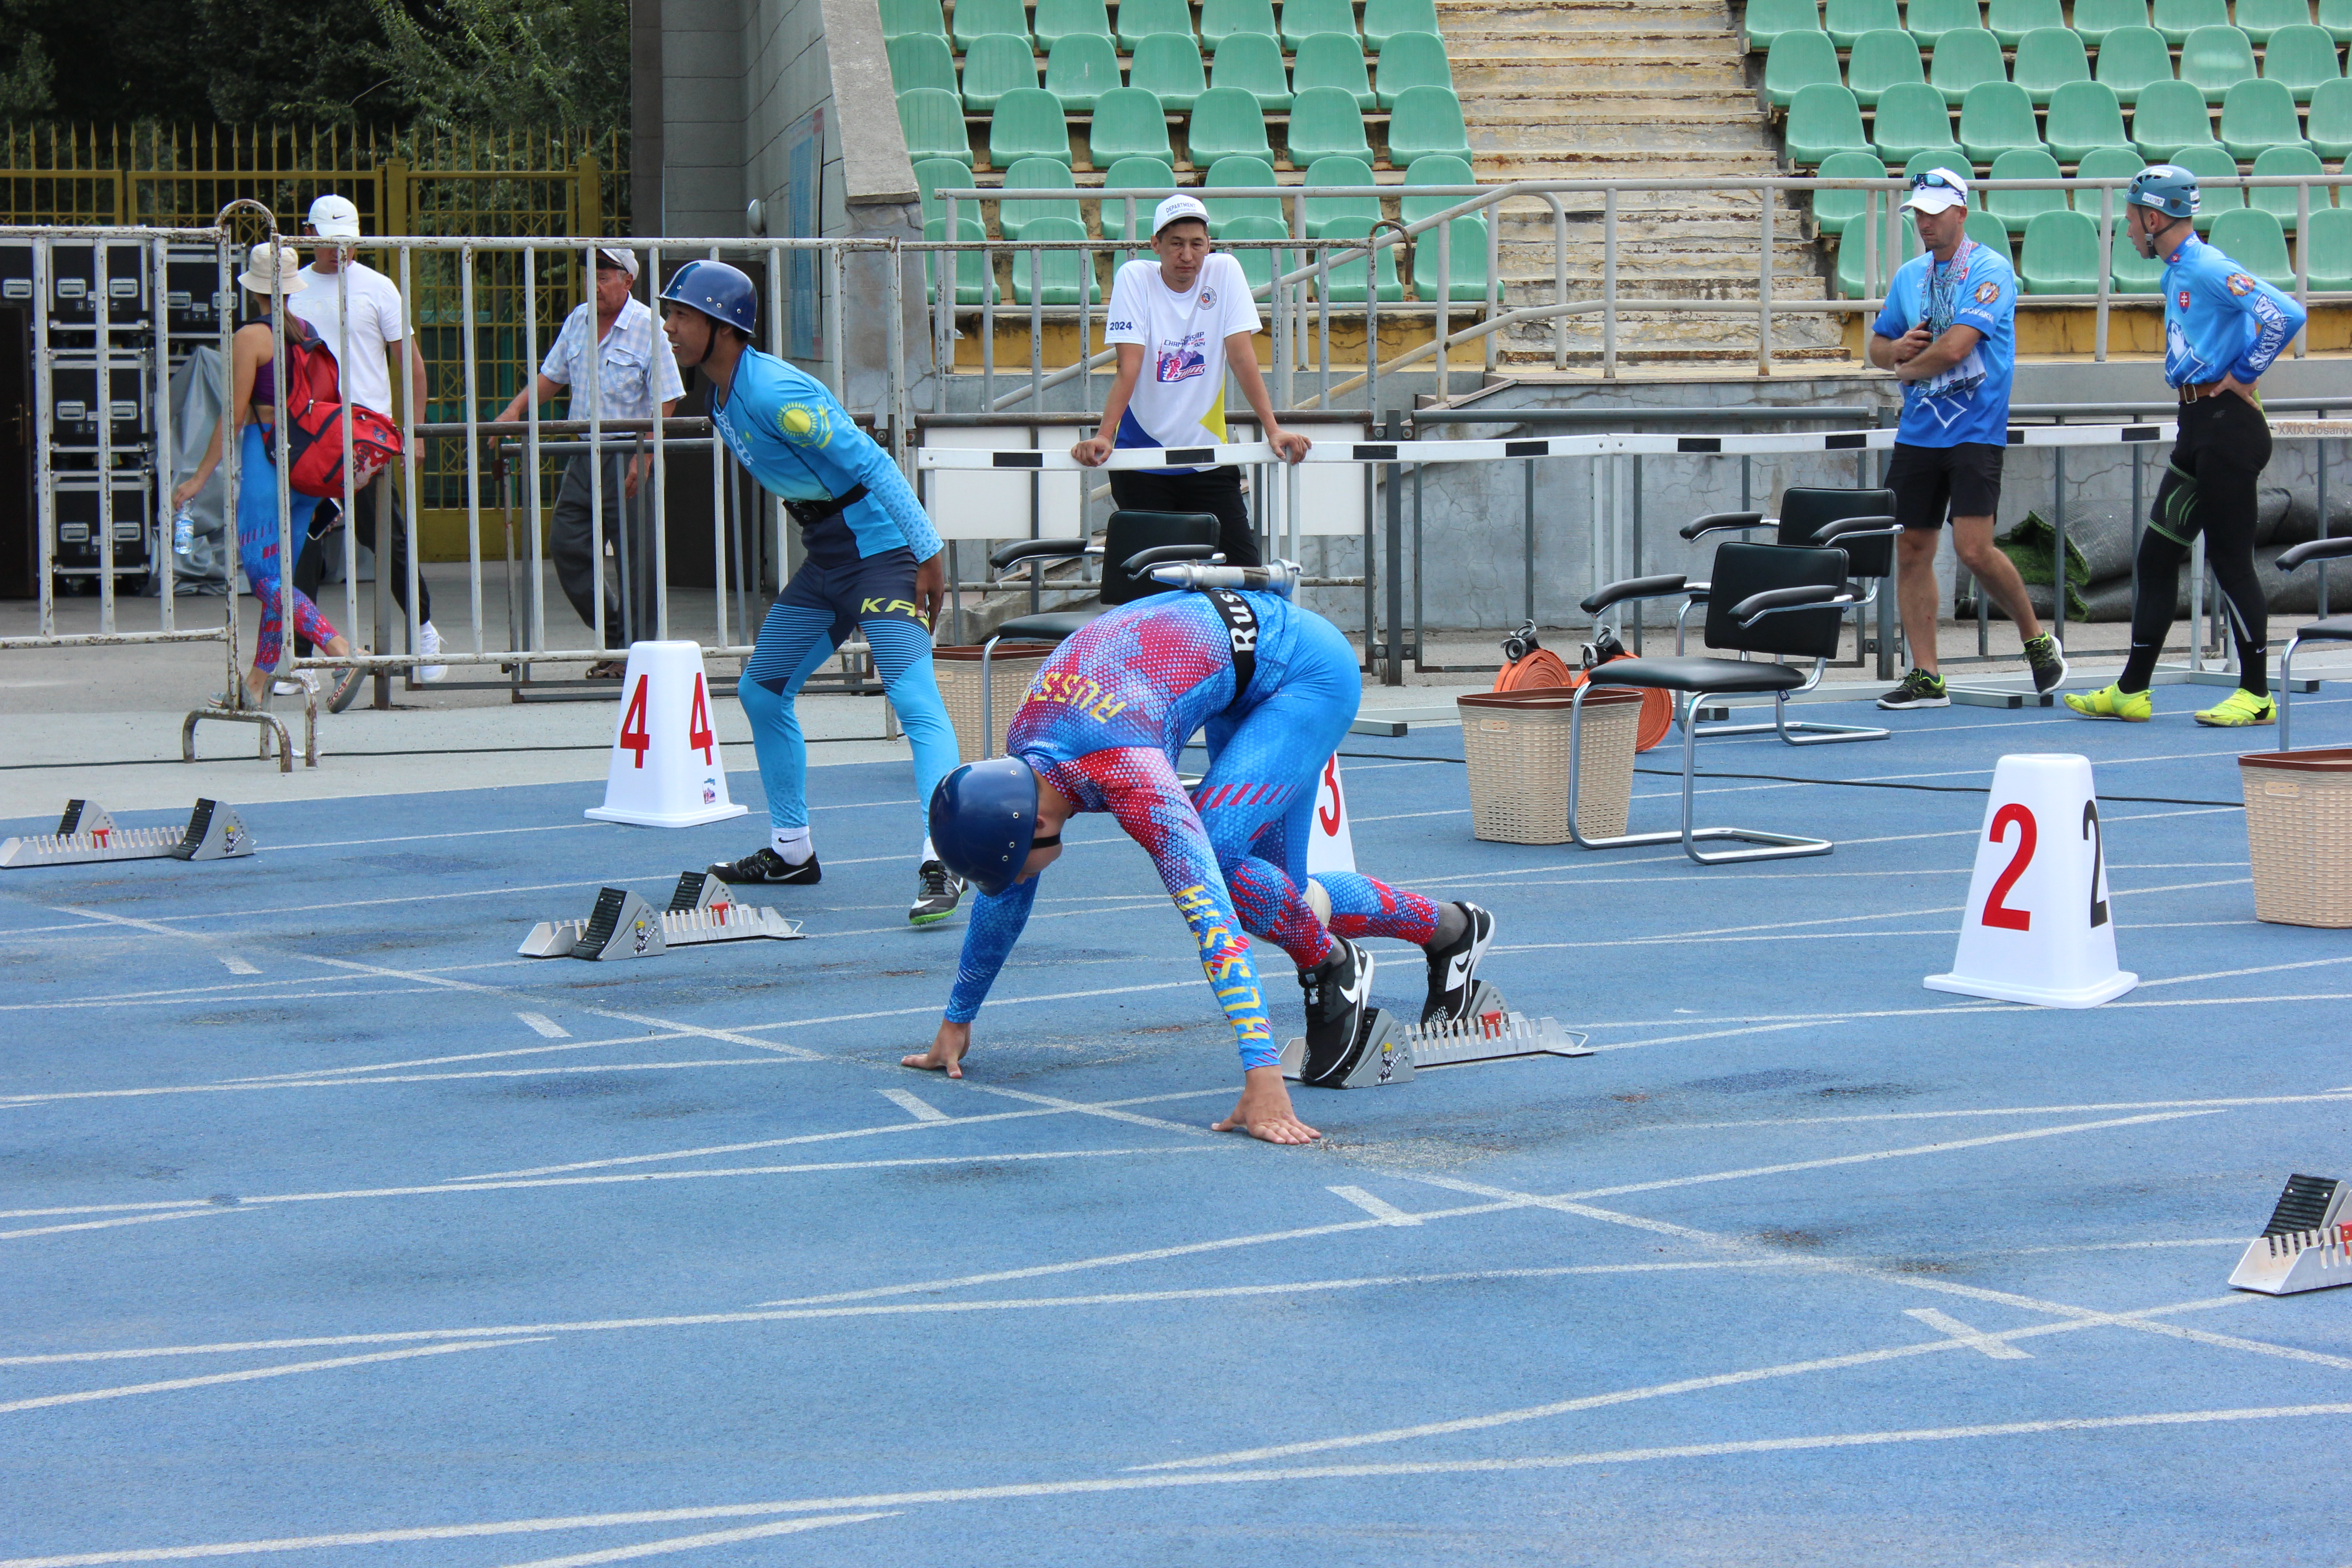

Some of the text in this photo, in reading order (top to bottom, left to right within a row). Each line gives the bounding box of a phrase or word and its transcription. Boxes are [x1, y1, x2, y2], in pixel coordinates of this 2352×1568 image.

[1166, 202, 1196, 213] DEPARTMENT
[1109, 321, 1132, 330] 2024
[2278, 425, 2304, 435] XXIX
[621, 675, 649, 769] 4
[690, 672, 713, 765] 4
[1318, 754, 1340, 837] 3
[1982, 804, 2037, 931] 2
[2083, 799, 2108, 929] 2
